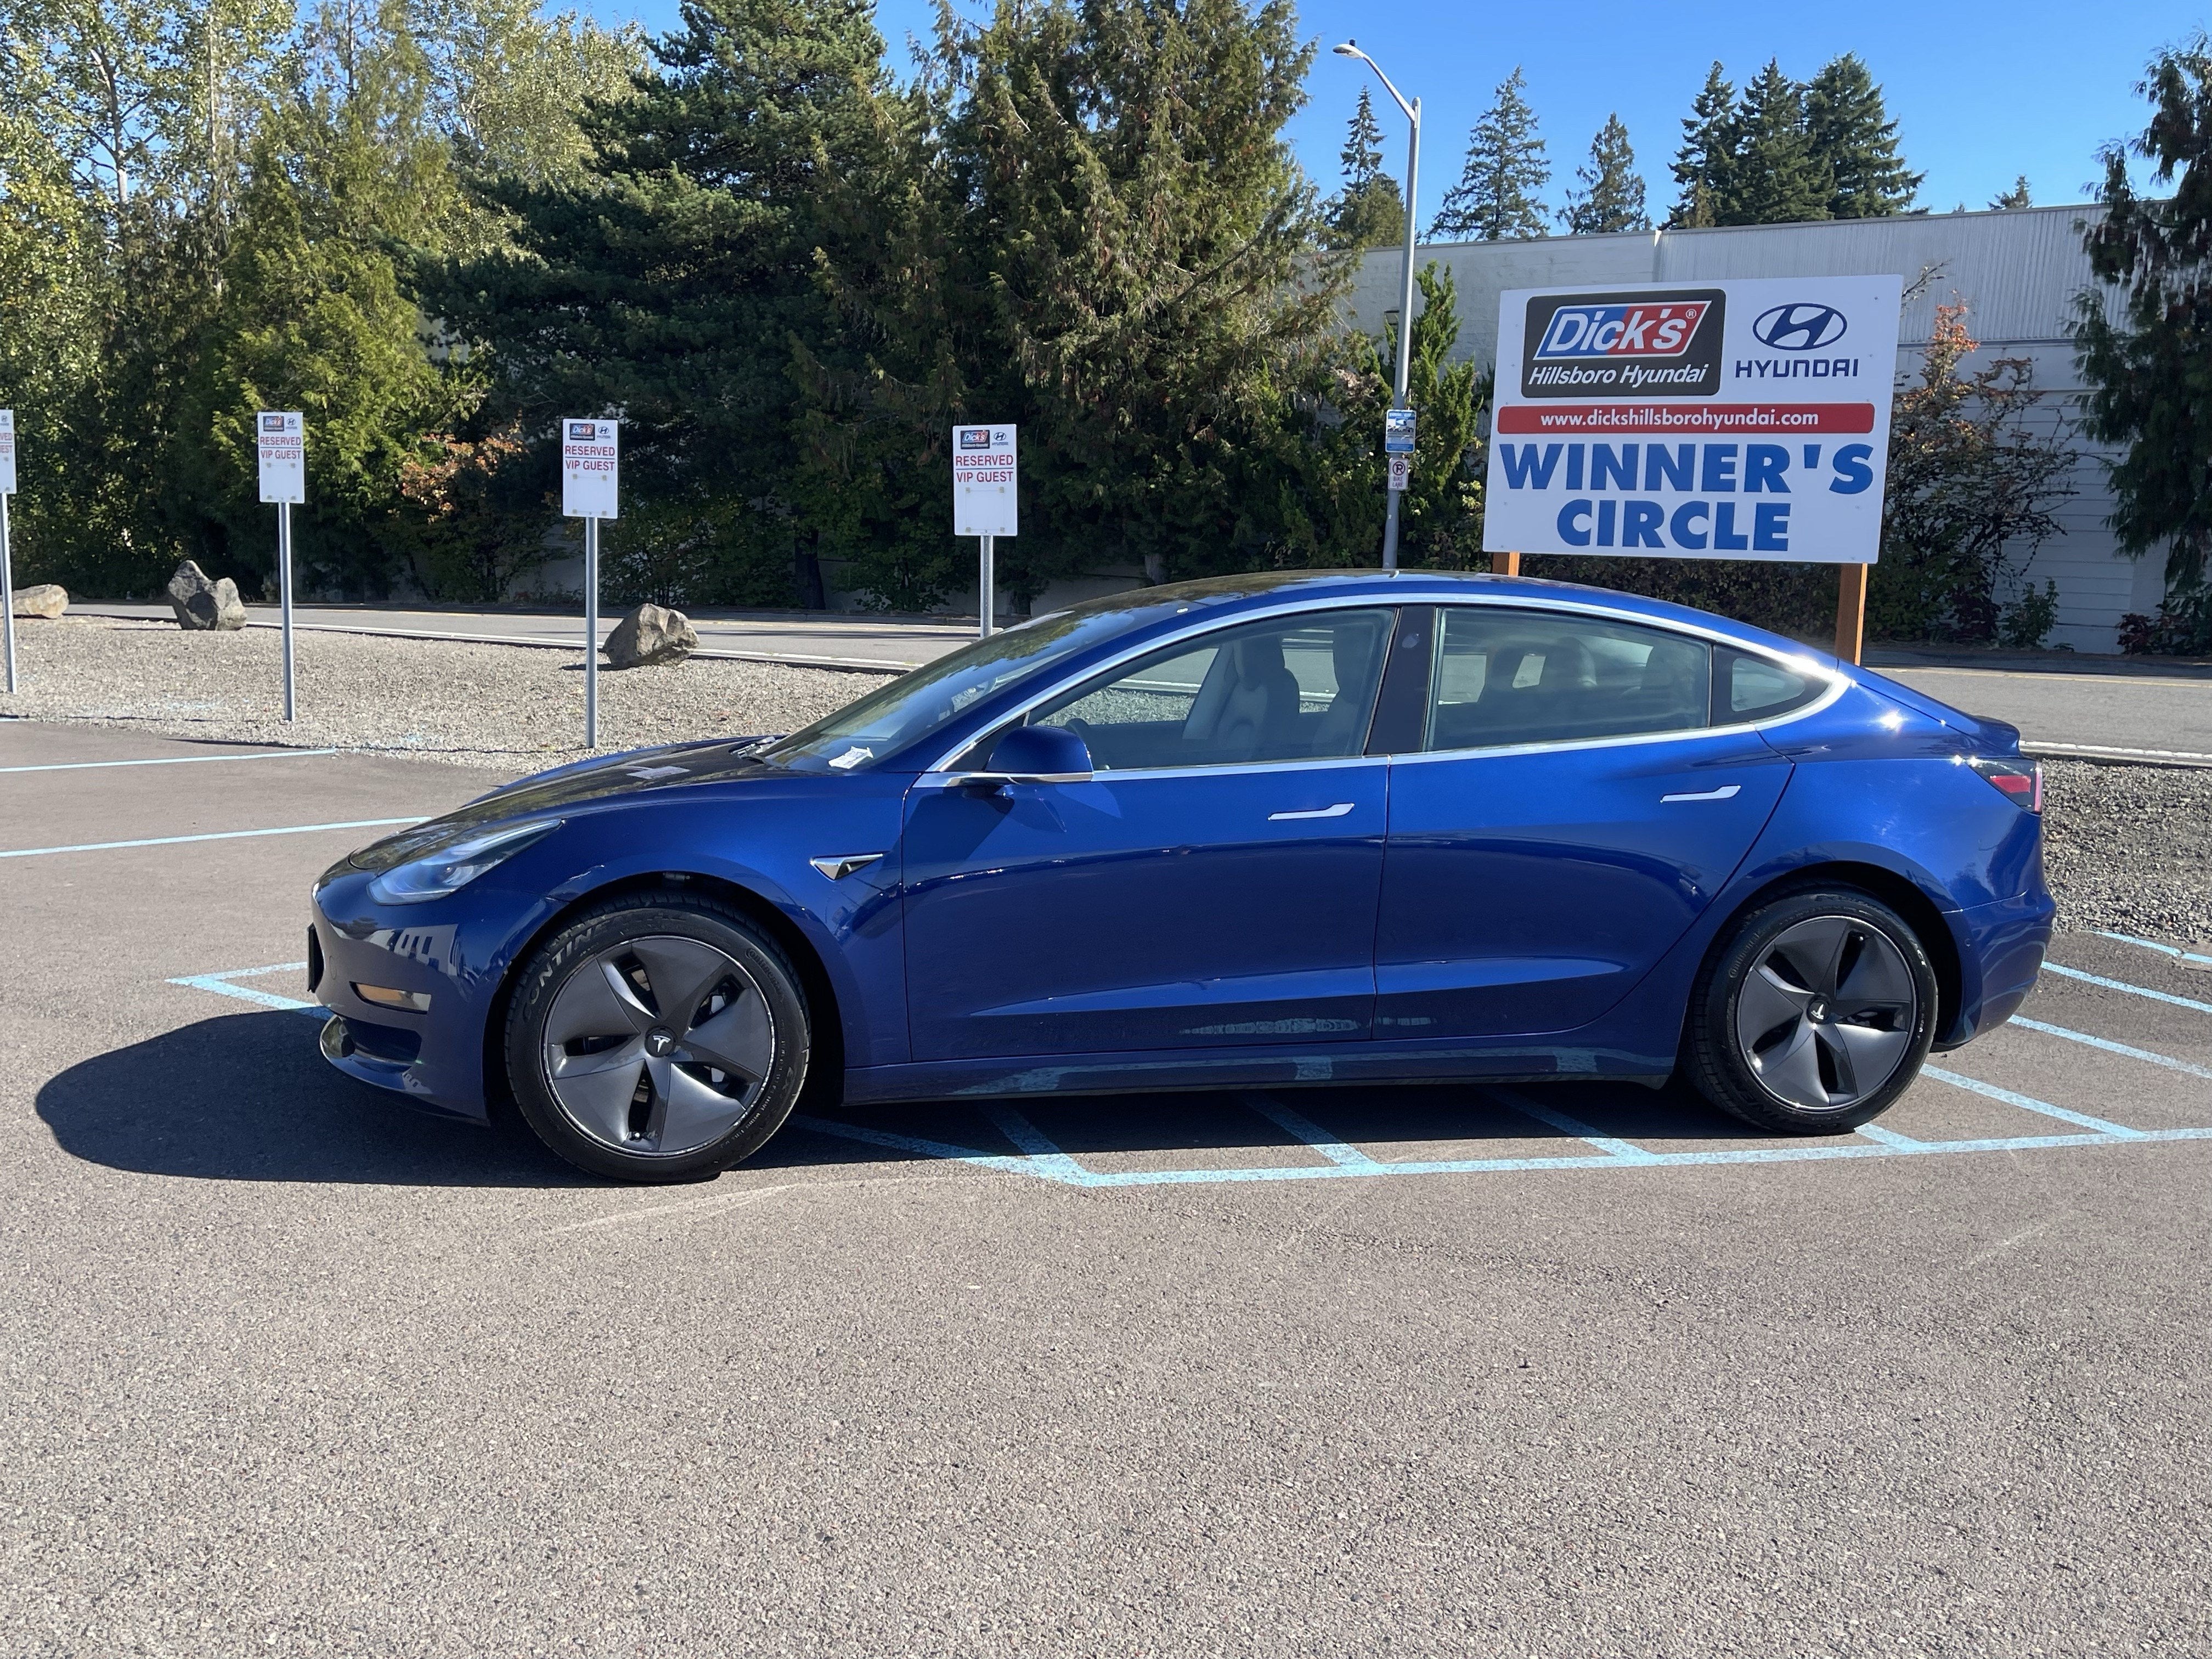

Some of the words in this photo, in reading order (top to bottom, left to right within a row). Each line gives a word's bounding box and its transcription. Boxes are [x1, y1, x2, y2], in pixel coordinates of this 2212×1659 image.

[1735, 358, 1859, 379] HYUNDAI
[1528, 366, 1617, 385] Hillsboro
[1619, 364, 1710, 388] Hyundai
[1540, 408, 1819, 430] www.dickshillsborohyundai.com
[259, 436, 301, 445] RESERVED
[260, 450, 273, 459] VIP
[275, 450, 301, 459] GUEST
[565, 445, 615, 456] RESERVED
[565, 459, 580, 470] VIP
[583, 460, 615, 471] GUEST
[956, 455, 1013, 466] RESERVED
[1499, 443, 1874, 495] WINNER'S
[956, 472, 973, 483] VIP
[977, 471, 1013, 482] GUEST
[1556, 499, 1791, 551] CIRCLE
